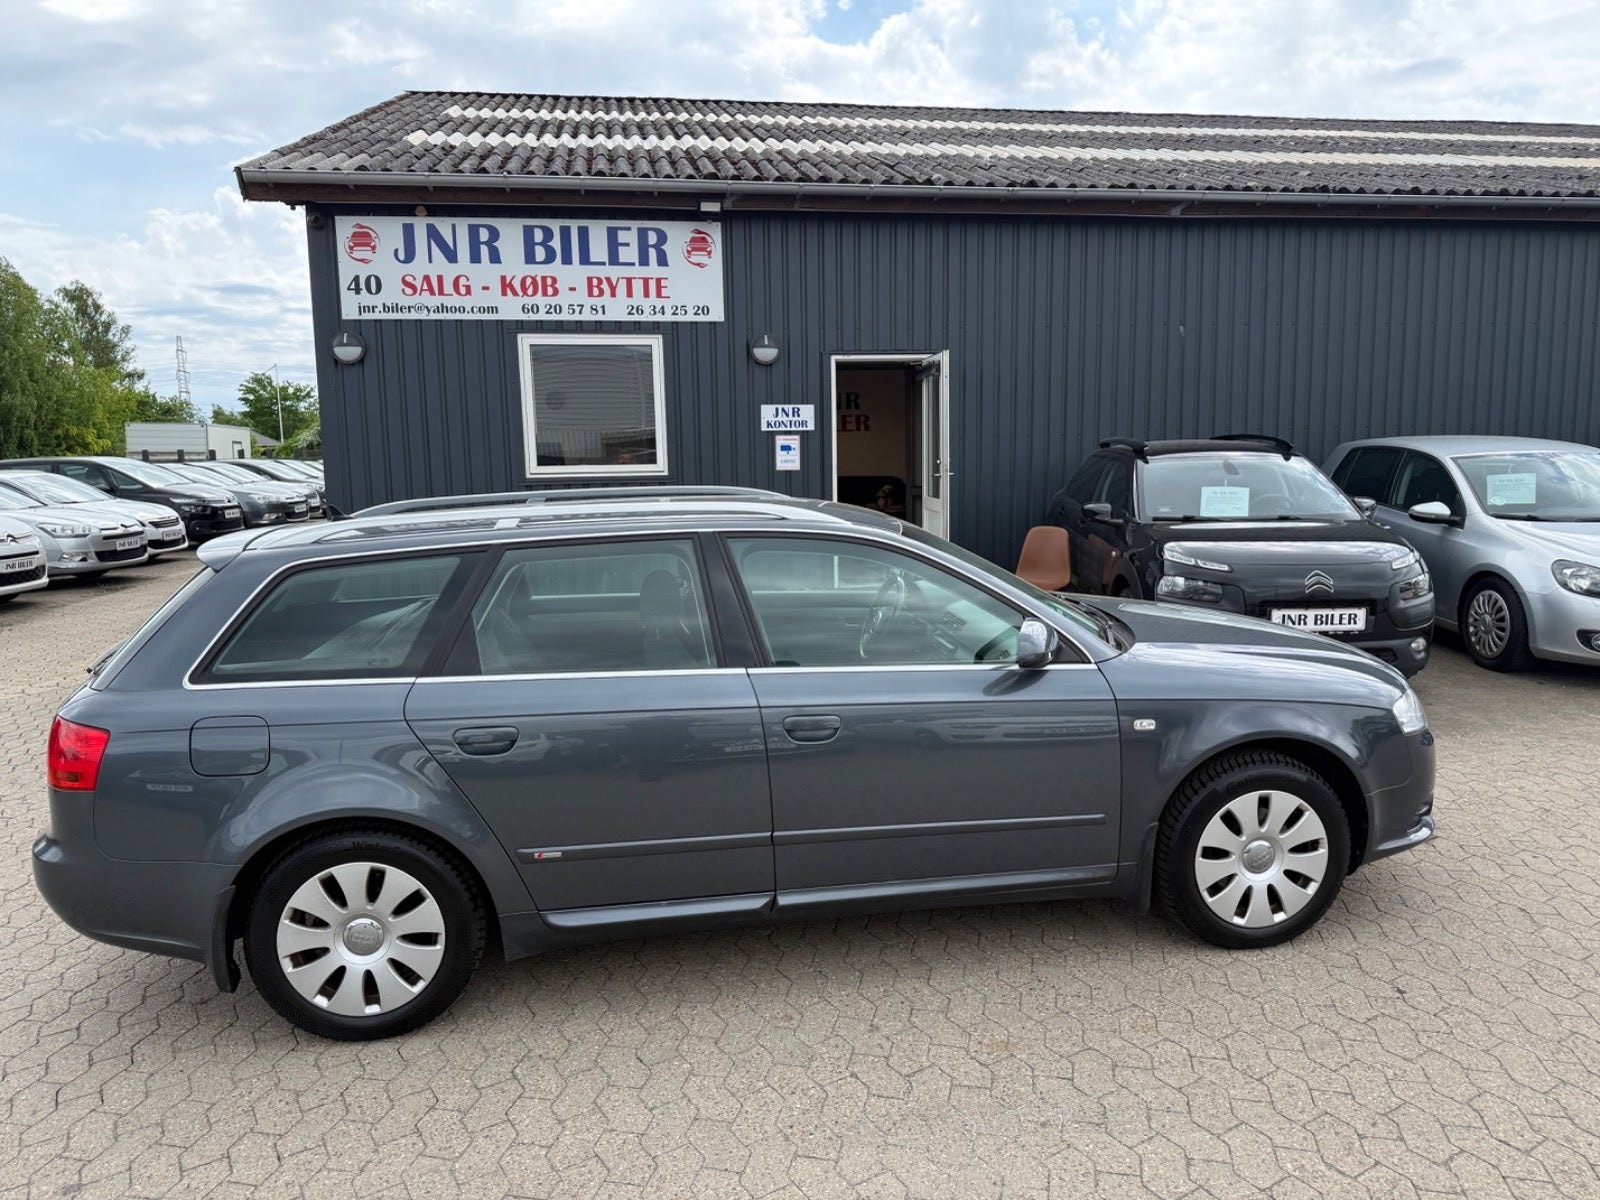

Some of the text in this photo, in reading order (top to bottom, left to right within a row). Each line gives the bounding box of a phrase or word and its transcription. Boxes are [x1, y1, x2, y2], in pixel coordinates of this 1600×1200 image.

[393, 222, 669, 267] JNR BILER
[347, 274, 383, 296] 40
[401, 273, 472, 297] SALG
[500, 274, 560, 298] KØB
[586, 276, 671, 299] BYTTE
[357, 302, 710, 317] jnr.biler@yahoo.com 60 20 57 81 26 34 25 20
[772, 406, 801, 419] JNR
[766, 419, 809, 429] KONTOR
[1279, 612, 1358, 626] JNR BILER
